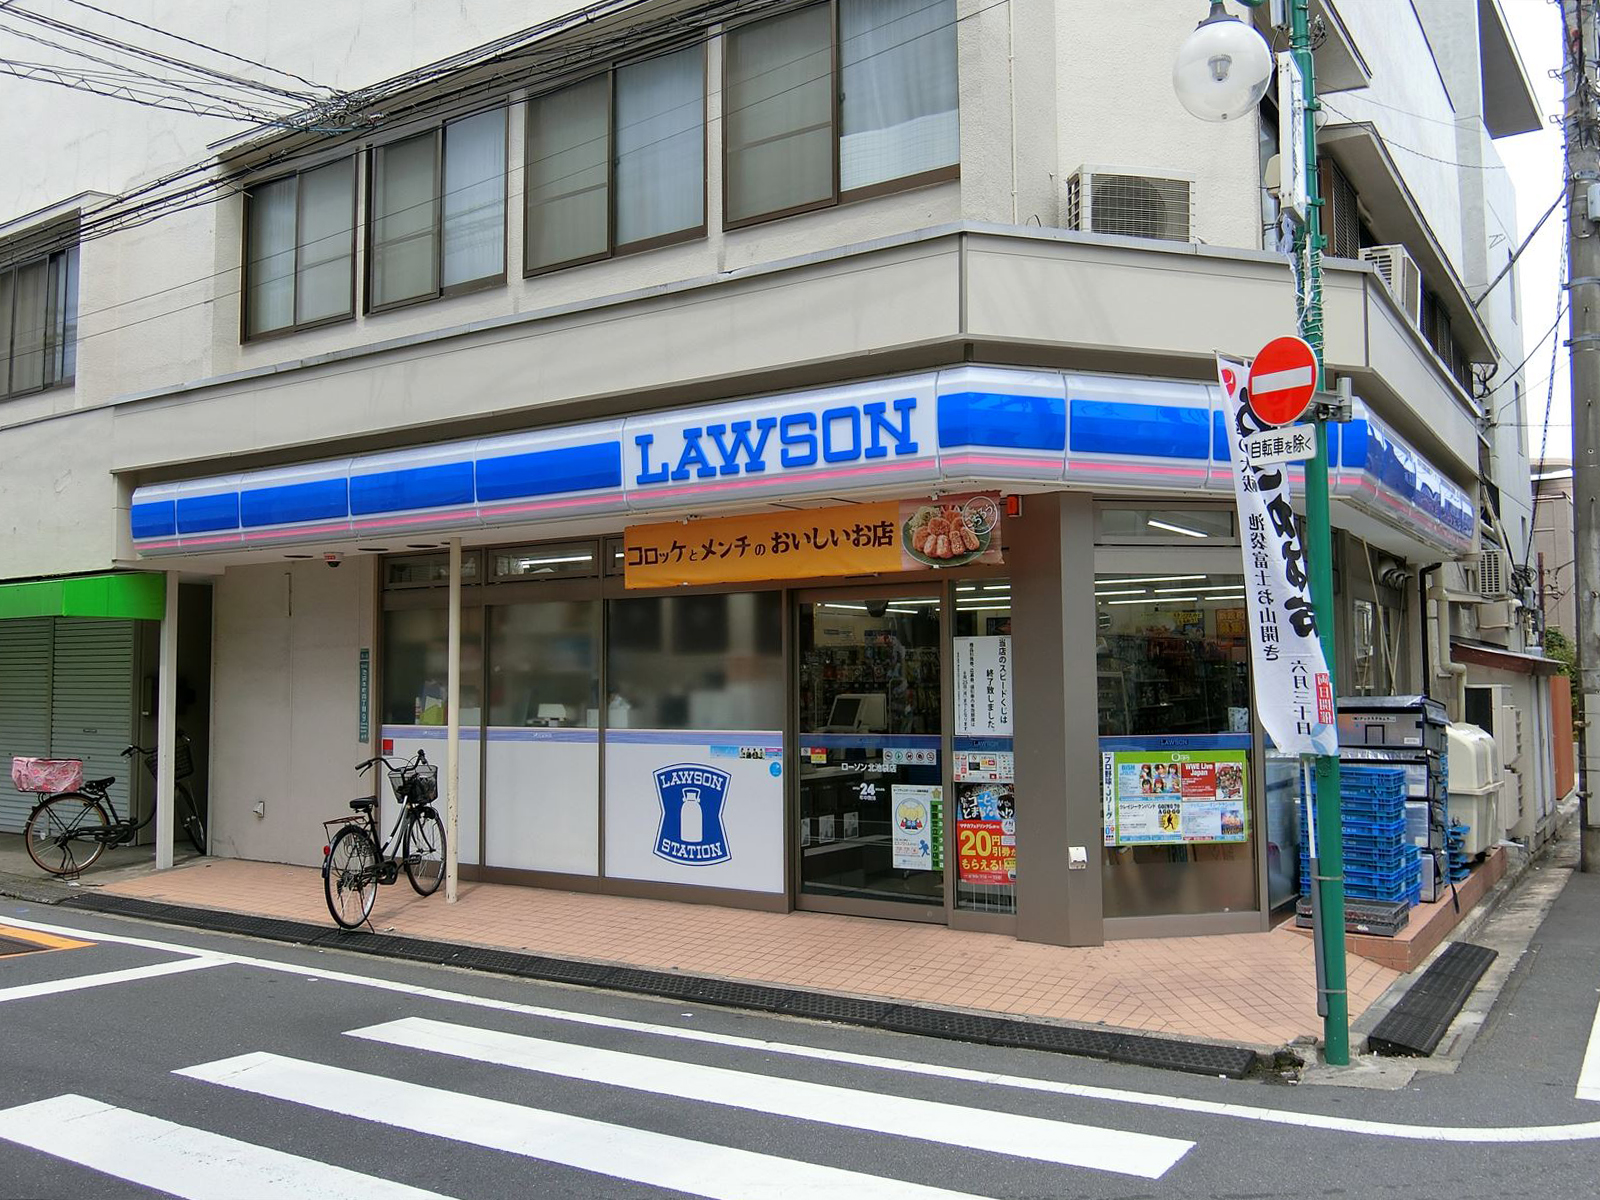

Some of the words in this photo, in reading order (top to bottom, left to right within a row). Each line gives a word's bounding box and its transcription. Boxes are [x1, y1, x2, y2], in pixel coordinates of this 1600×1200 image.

[635, 397, 918, 485] LAWSON
[1251, 434, 1312, 458] 自転車を除く
[627, 520, 894, 567] コロッケとメンチのおいしいお店
[998, 637, 1008, 724] 当店のスピードくじは
[660, 771, 723, 791] LAWSON
[860, 783, 876, 795] 24
[662, 838, 722, 859] STATION
[962, 859, 1002, 871] もらえる!
